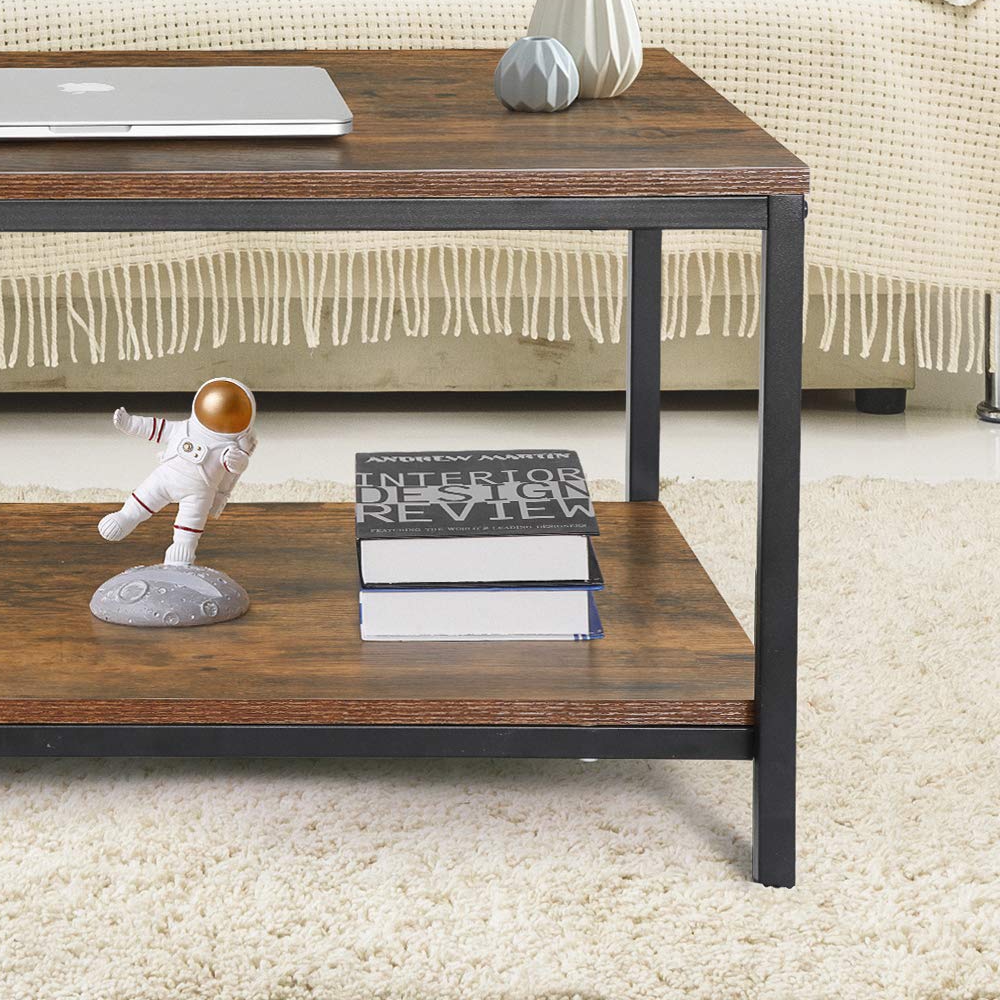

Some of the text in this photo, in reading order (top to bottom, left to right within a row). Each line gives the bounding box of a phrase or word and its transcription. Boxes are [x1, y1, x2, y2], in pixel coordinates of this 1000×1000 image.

[357, 467, 586, 487] INTERIOR
[358, 480, 590, 503] DESIGN
[356, 499, 596, 523] REVIEW
